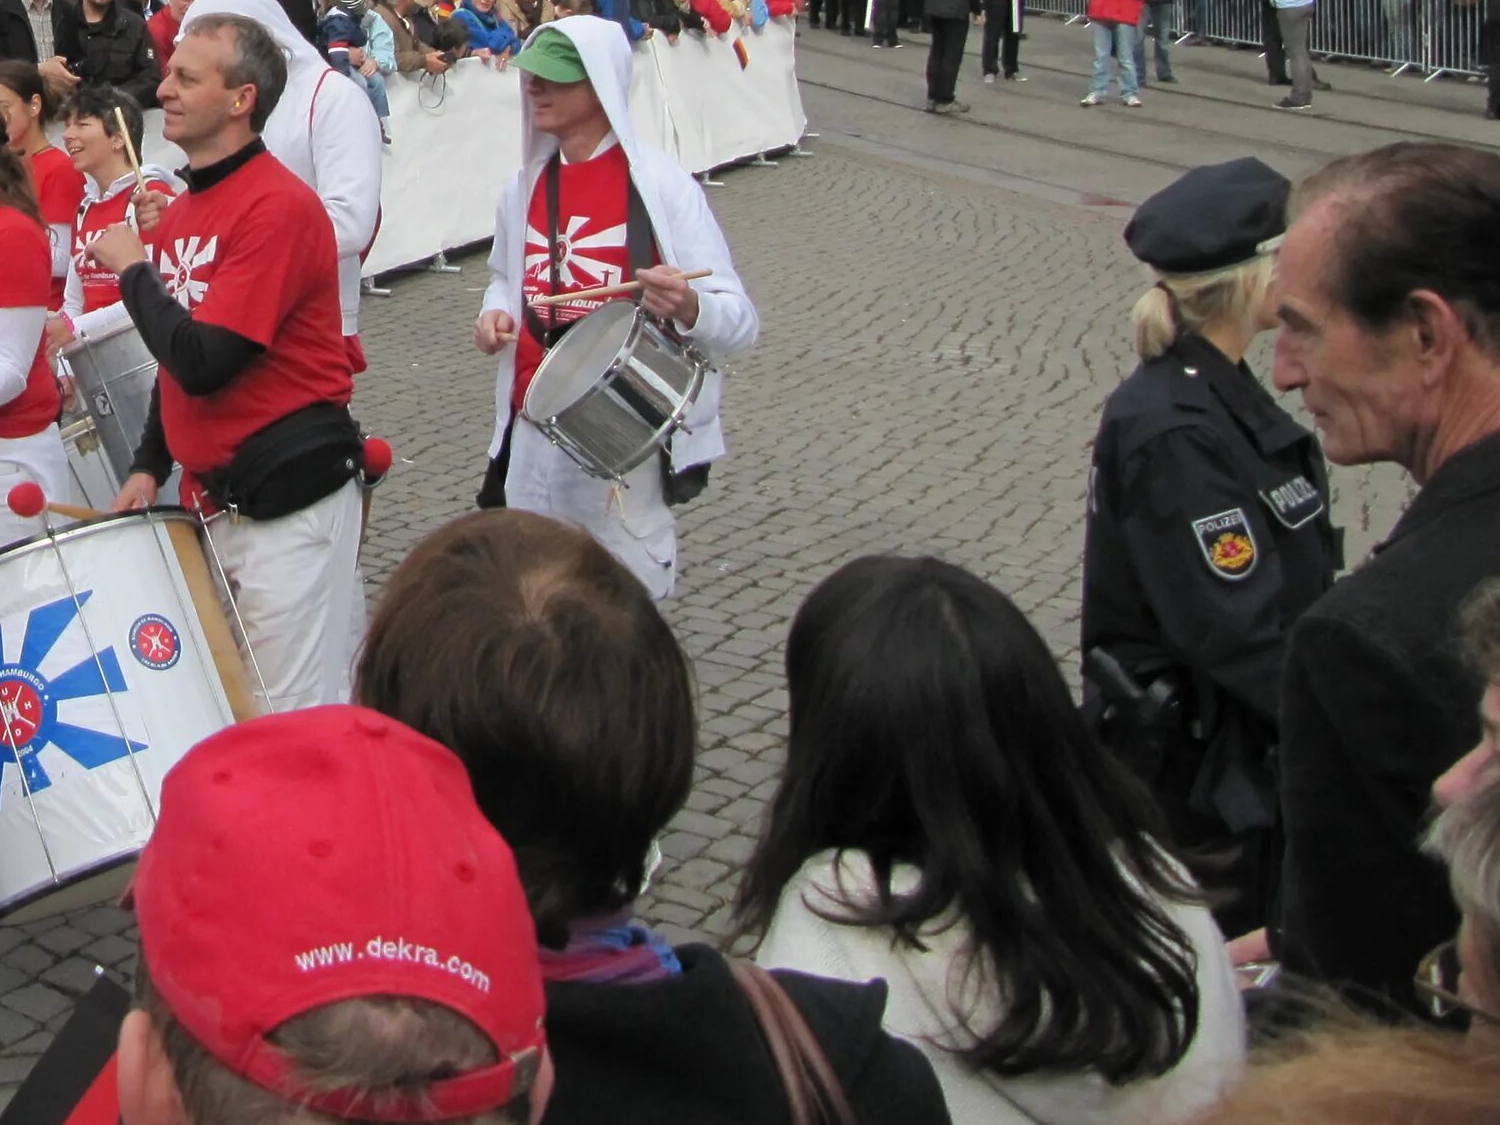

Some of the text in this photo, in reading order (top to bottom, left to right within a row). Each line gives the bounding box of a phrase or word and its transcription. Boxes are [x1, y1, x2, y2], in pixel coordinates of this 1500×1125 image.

[1200, 514, 1242, 534] POLIZEI
[0, 669, 45, 691] HAMBURGO
[294, 935, 490, 994] www.dekra.com
